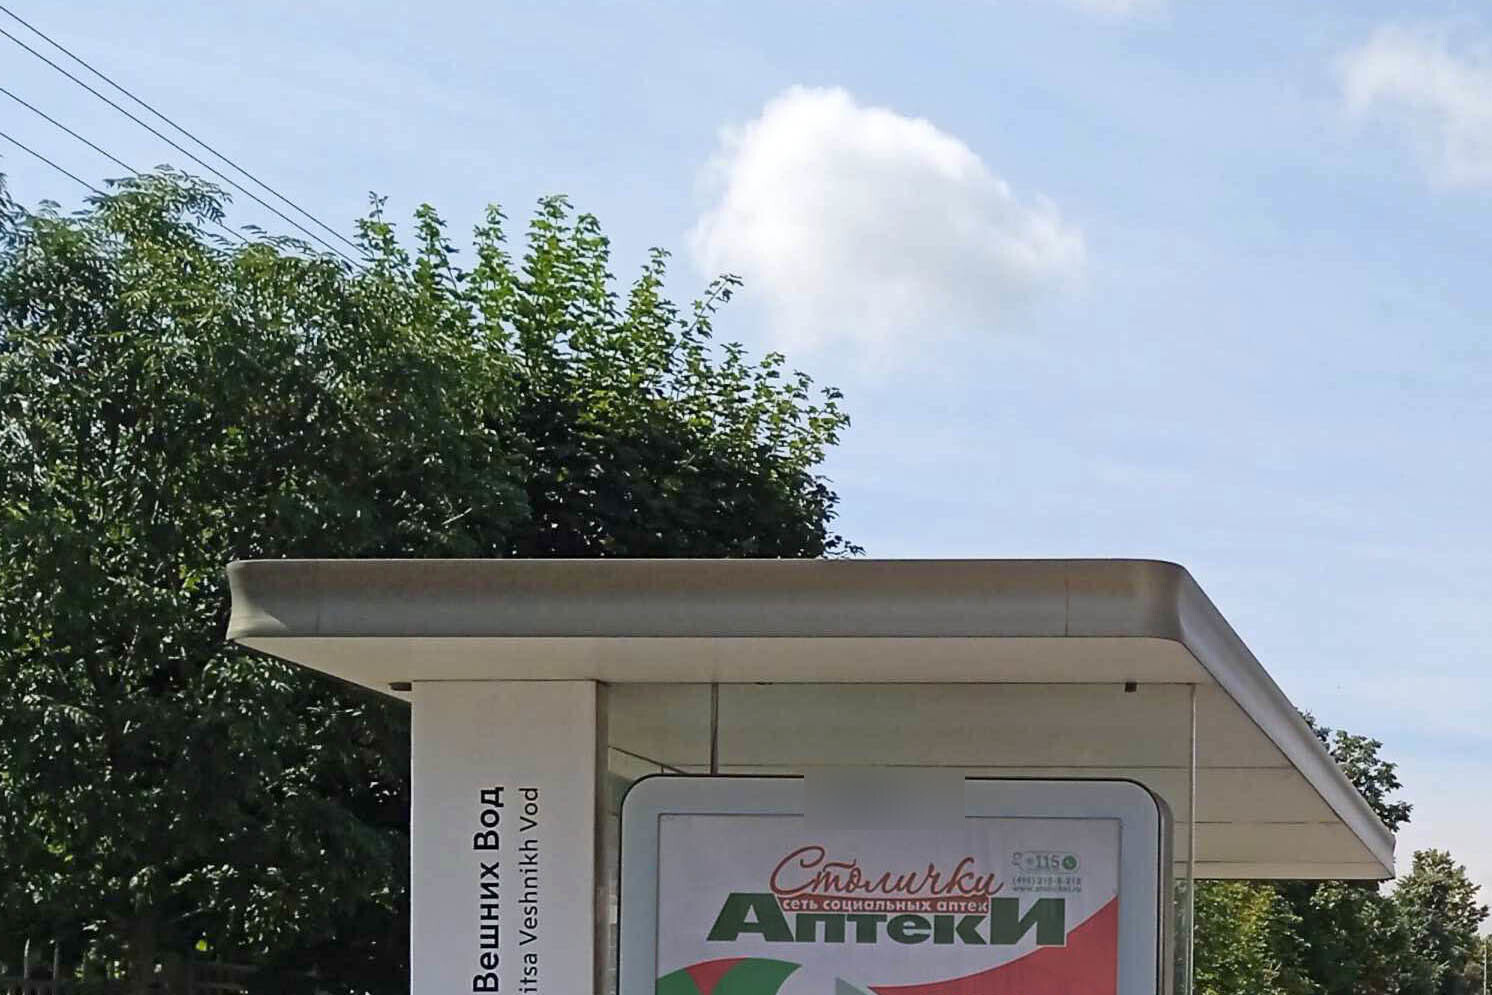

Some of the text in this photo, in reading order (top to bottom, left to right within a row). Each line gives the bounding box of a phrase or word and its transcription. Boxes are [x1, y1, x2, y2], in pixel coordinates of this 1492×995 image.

[473, 787, 504, 850] Вод
[518, 787, 539, 831] Vod
[518, 839, 539, 946] Veshnikh
[769, 845, 1004, 896] Столички
[473, 861, 500, 993] Вешних
[782, 897, 989, 913] сеть социальных аптек
